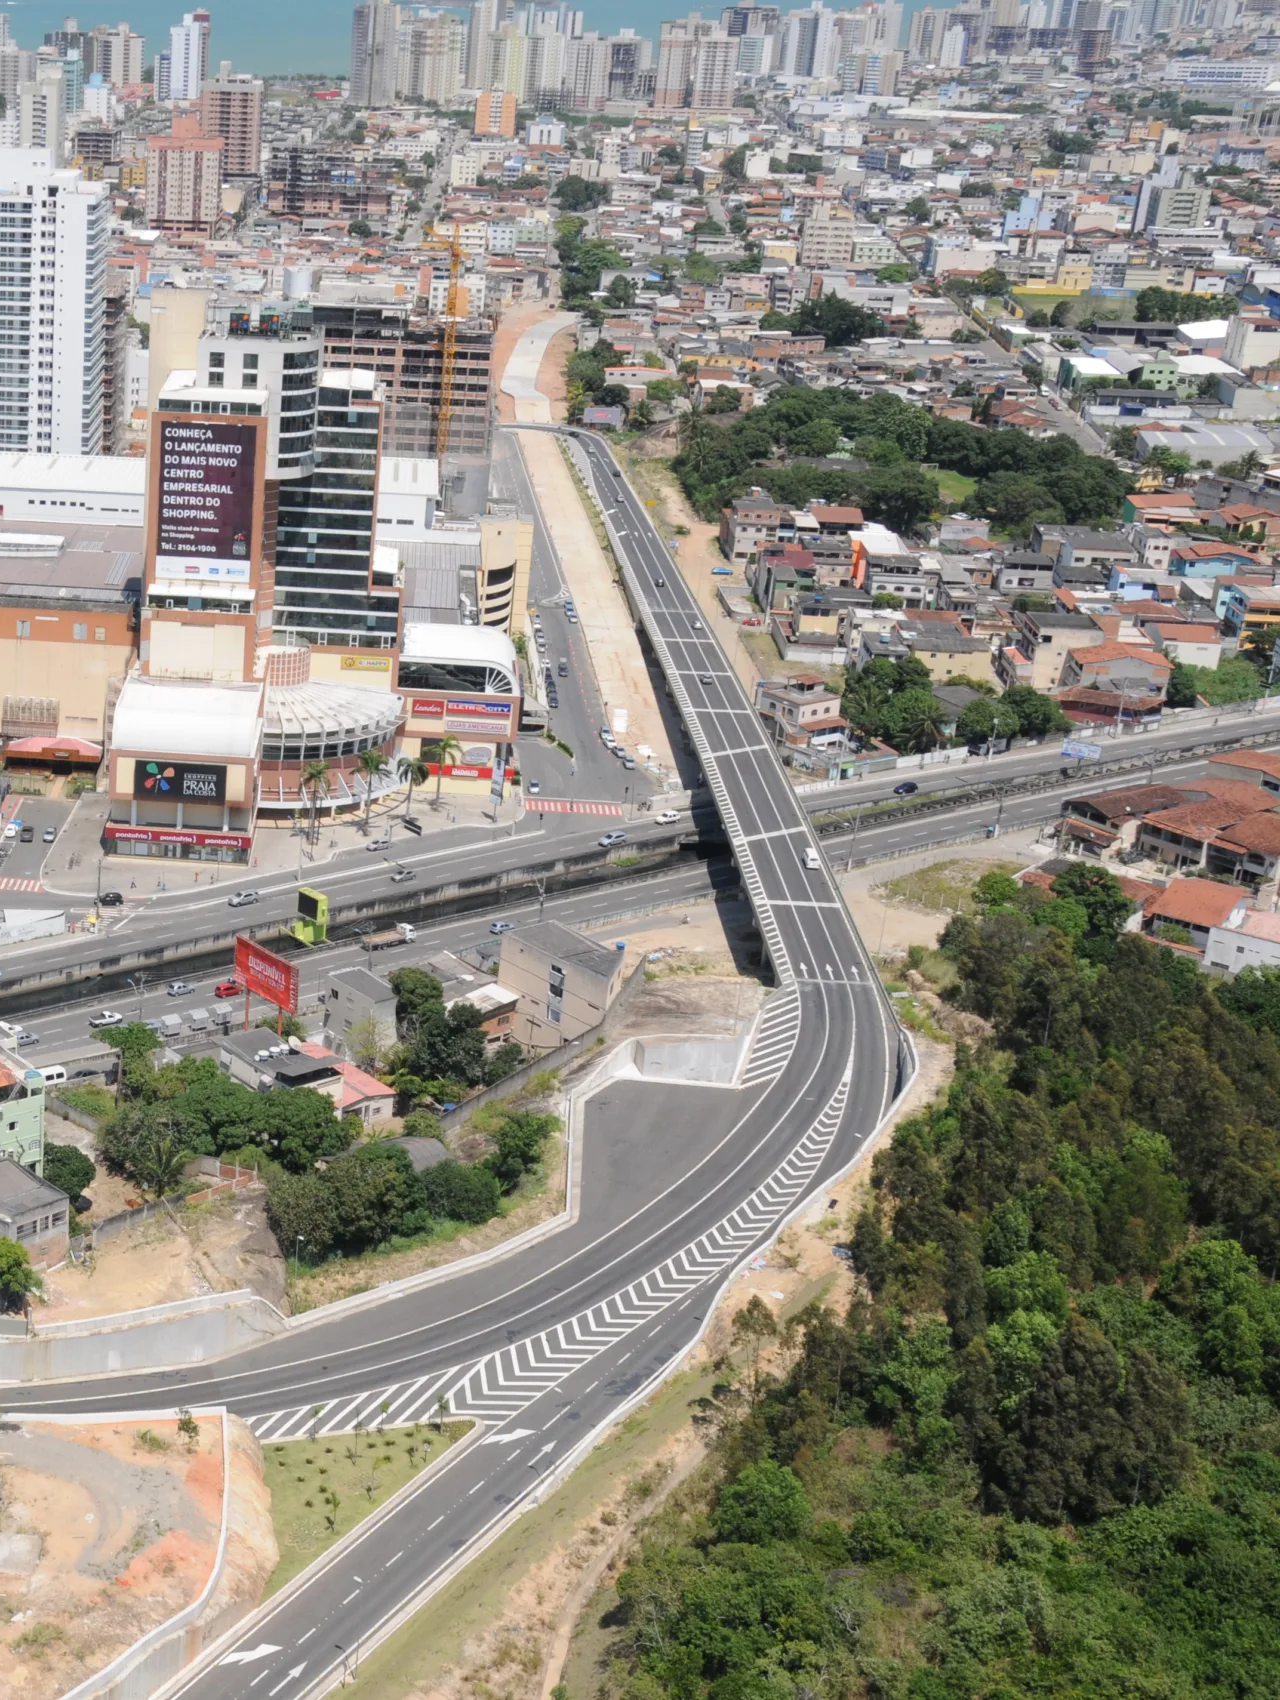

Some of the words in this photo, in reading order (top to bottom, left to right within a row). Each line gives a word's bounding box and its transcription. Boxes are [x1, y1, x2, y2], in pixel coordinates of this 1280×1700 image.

[165, 427, 213, 440] CONHEÇA
[165, 441, 173, 450] O
[174, 442, 242, 454] LANÇAMENTO
[164, 455, 179, 464] DO
[181, 456, 206, 465] MAIS
[208, 457, 237, 467] NOVO
[163, 469, 204, 478] CENTRO
[163, 482, 233, 494] EMPRESARIAL
[163, 495, 204, 505] DENTRO
[205, 497, 220, 506] DO
[162, 508, 217, 520] SHOPPING.
[161, 542, 176, 550] Tel.:
[177, 544, 217, 552] 2104-1900
[414, 703, 442, 712] Leader
[467, 723, 507, 731] AMERICANAS
[183, 780, 216, 791] PRAIA
[248, 955, 286, 985] DISPONÍVEL
